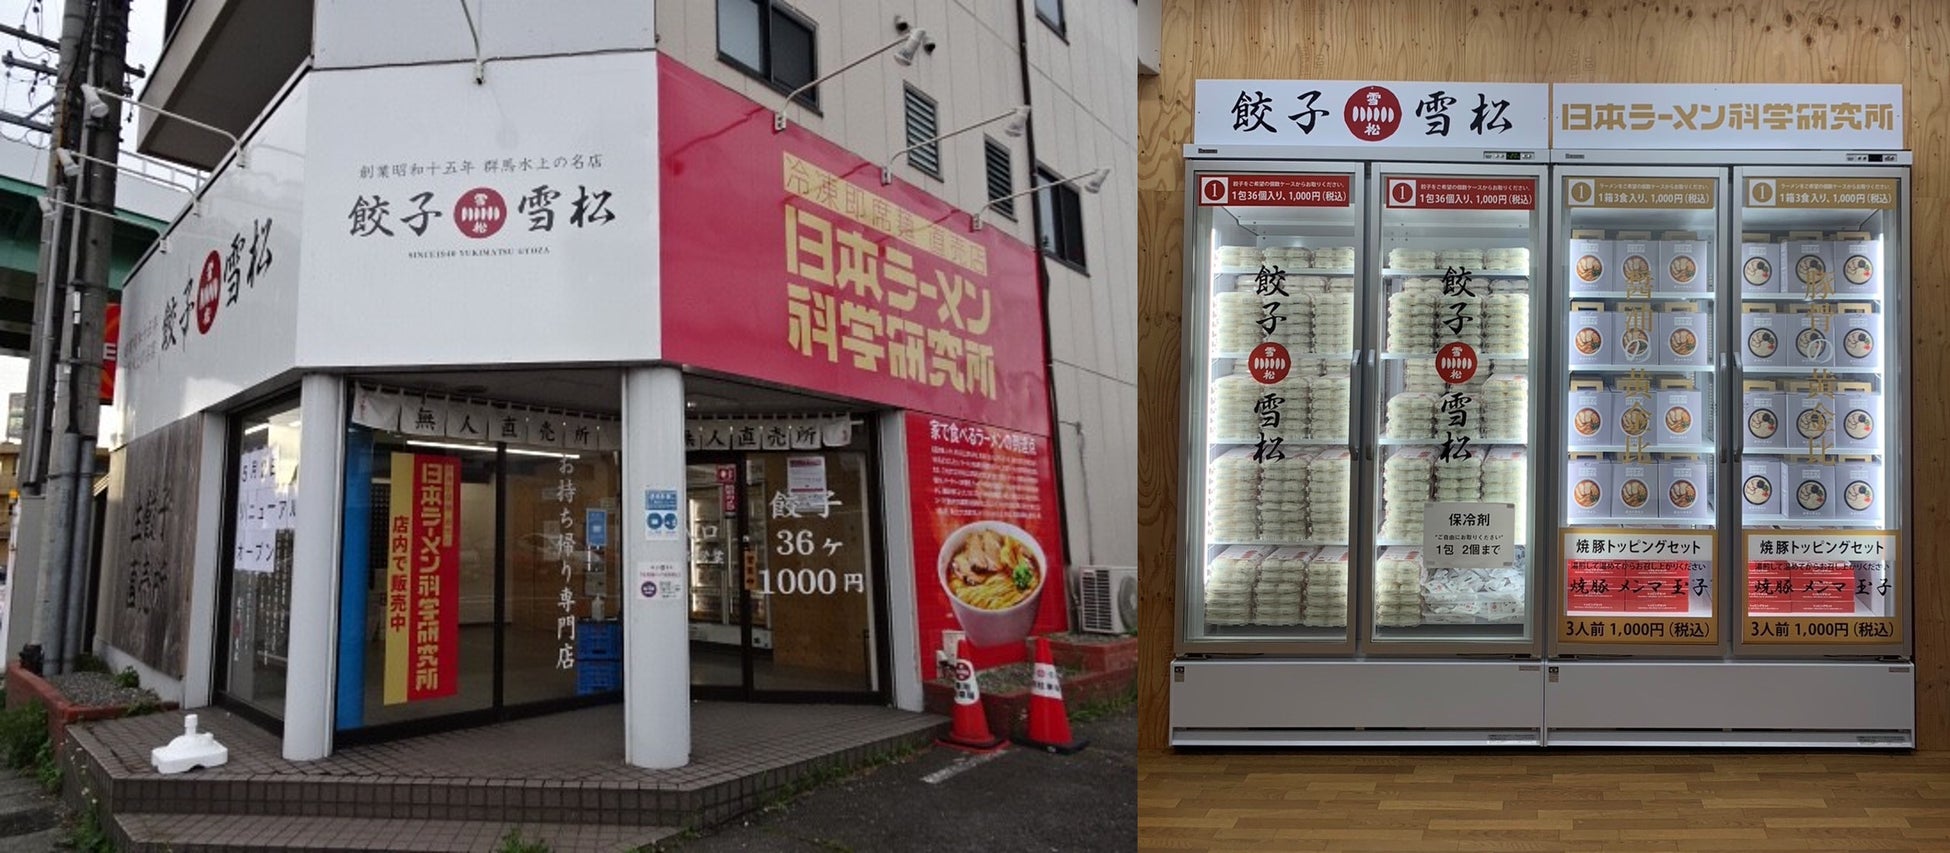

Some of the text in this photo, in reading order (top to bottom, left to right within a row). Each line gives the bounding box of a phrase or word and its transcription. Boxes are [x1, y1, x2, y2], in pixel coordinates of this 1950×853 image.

[1367, 92, 1382, 106] 雪
[1231, 90, 1513, 137] 餃子 雪松
[1561, 102, 1894, 131] 日本ラーメン科学研究所
[1364, 123, 1381, 136] 松
[359, 153, 603, 179] 創業昭和十五年 群馬水上の名店
[1231, 190, 1347, 202] 1包36個入り、1,000円（税込）
[1419, 193, 1533, 205] 1包36個入り、1,000円（税込）
[1598, 192, 1710, 204] 1箱3食入り、1,000円（税込）
[1779, 192, 1892, 204] 1箱3食入り、1,000円（税込）
[348, 184, 616, 238] 餃子 雪松
[784, 203, 992, 336] 日本ラーメン
[787, 281, 997, 401] 科学研究所
[1252, 264, 1290, 464] 餃子 雪松
[1439, 265, 1477, 464] 餃子 雪松
[1624, 269, 1653, 465] 醤油の黄金比
[1805, 270, 1836, 466] 豚骨の黄金比
[414, 407, 590, 445] 無人直売所
[770, 489, 843, 520] 餃子
[1448, 513, 1490, 527] 保冷剤
[1436, 544, 1501, 556] 1包 2個まで
[1575, 538, 1701, 556] 焼豚トッピングセット
[1760, 538, 1885, 556] 焼豚トッピングセット
[390, 515, 410, 633] 店内で販売中
[556, 454, 577, 670] お持ち帰り専門店
[415, 463, 443, 692] 日本ラーメン科学研究所
[758, 568, 865, 595] 1000円
[1570, 577, 1709, 597] 焼豚 メンマ 玉子
[1754, 578, 1893, 597] 焼豚 メンマ 玉子
[1566, 621, 1710, 638] 3人前 1,000円（税込）
[1751, 621, 1895, 638] 3人前 1,000円（税込）
